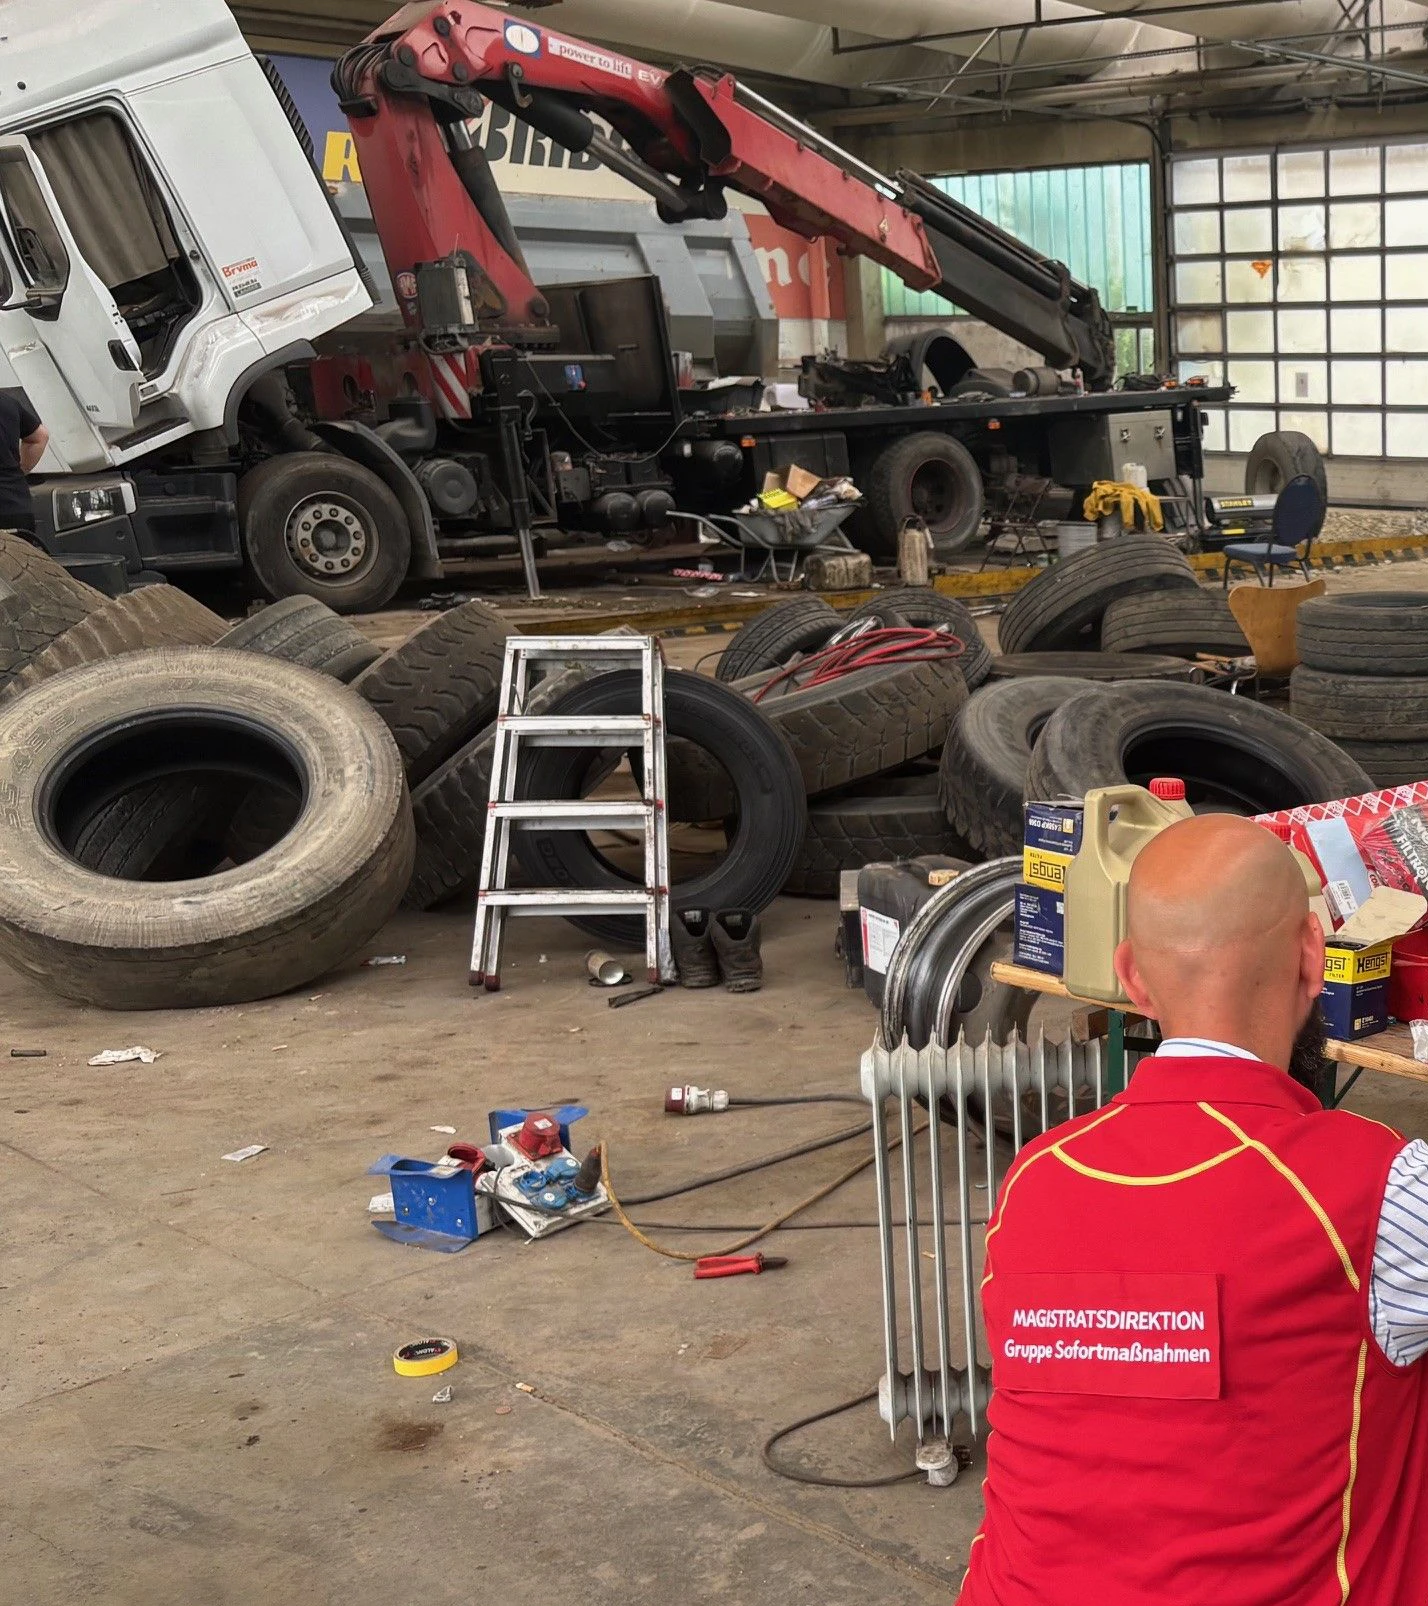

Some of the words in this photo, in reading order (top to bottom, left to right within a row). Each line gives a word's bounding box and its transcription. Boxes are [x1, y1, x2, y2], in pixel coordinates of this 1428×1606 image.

[559, 43, 595, 63] power
[599, 57, 610, 68] to
[612, 59, 630, 76] lift
[1325, 956, 1347, 972] gst
[1357, 952, 1389, 974] Hengst
[1012, 1309, 1205, 1331] MAGISTRATSDIREKTION
[1004, 1338, 1053, 1364] Gruppe
[1055, 1339, 1211, 1363] Sofortmaßnahmen
